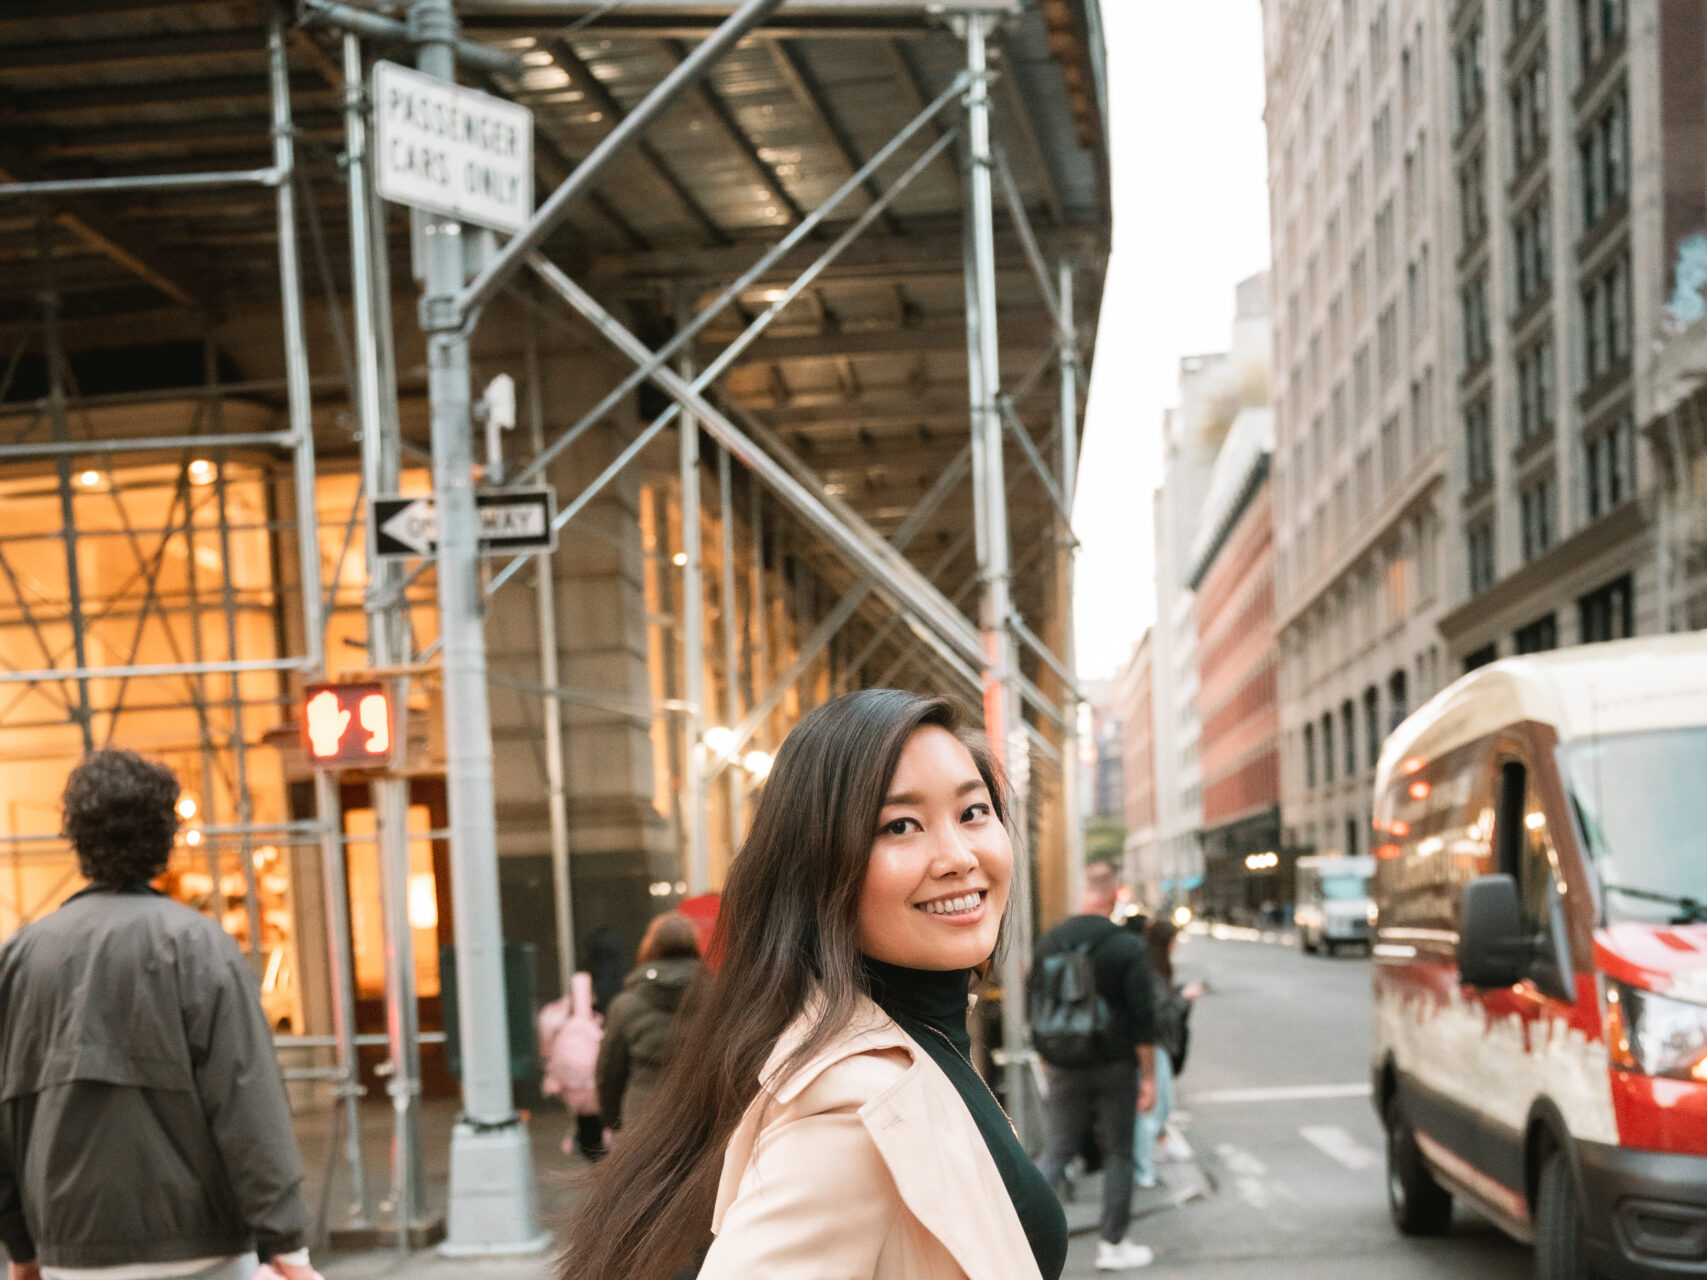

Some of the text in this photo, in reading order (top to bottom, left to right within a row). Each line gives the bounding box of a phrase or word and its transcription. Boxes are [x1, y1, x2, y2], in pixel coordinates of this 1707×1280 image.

[390, 87, 520, 157] PASSENGER
[391, 135, 519, 203] CARS ONLY
[481, 509, 532, 534] WAY
